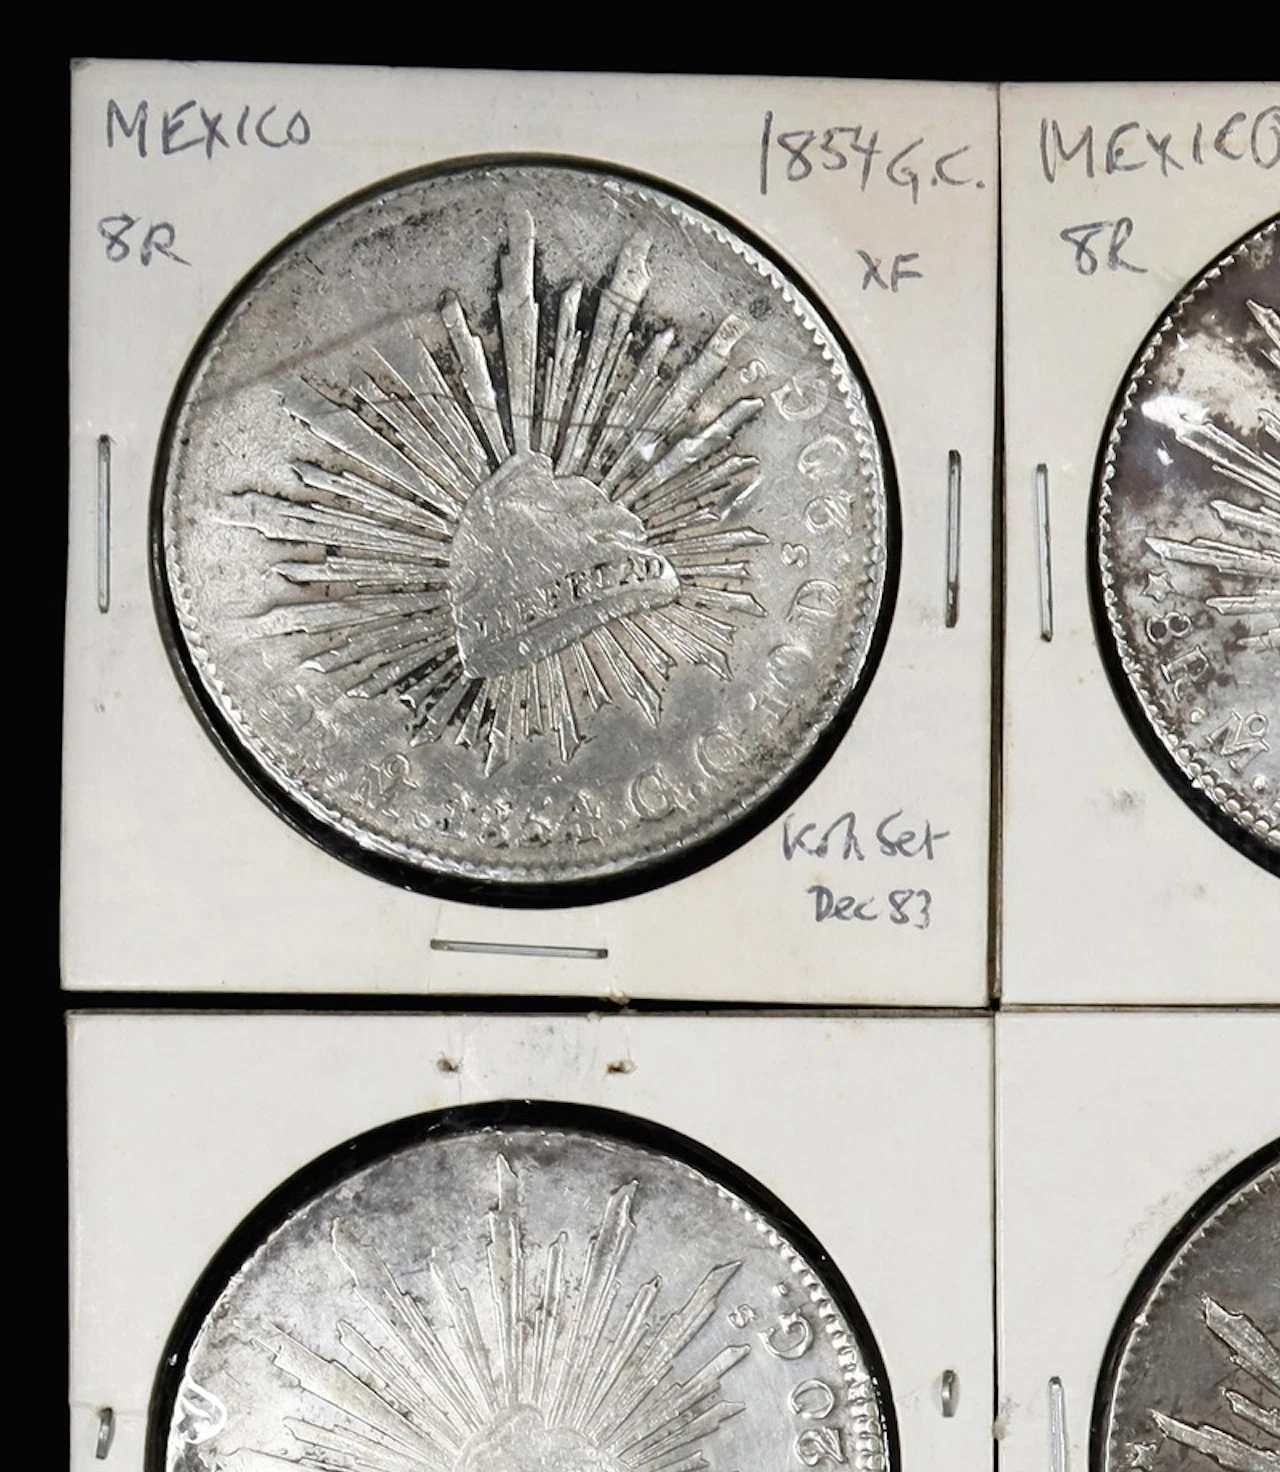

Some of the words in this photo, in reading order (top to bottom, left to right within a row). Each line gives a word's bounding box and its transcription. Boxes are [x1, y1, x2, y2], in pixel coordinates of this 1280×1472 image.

[105, 97, 312, 161] MEXICO
[97, 213, 194, 268] 8R
[1060, 218, 1149, 277] 8R
[857, 249, 923, 291] XF
[807, 885, 879, 923] Dec
[888, 888, 933, 930] 83
